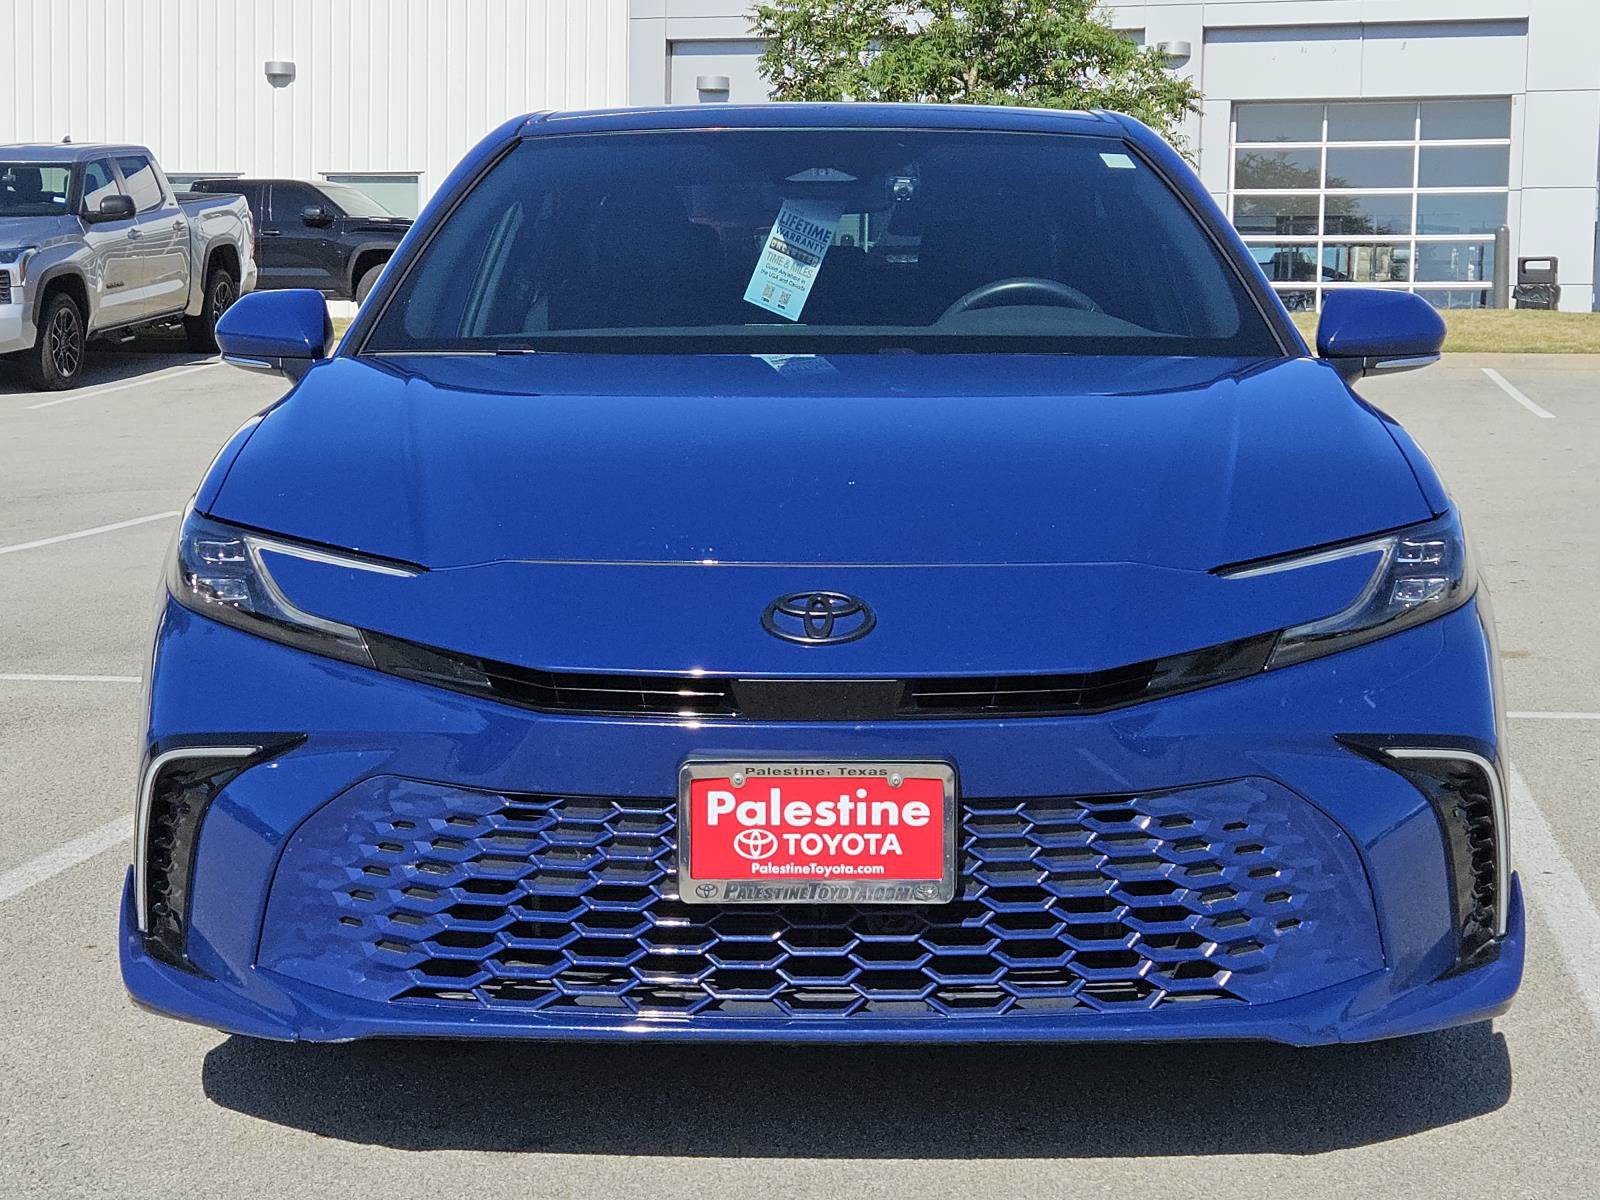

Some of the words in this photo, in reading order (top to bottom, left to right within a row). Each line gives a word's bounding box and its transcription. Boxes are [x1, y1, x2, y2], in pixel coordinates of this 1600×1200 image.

[776, 226, 825, 253] WARRANTY
[778, 211, 832, 243] LIFETIME
[765, 251, 784, 267] TIME
[789, 261, 813, 279] MILES
[745, 767, 830, 776] Palestine,
[838, 767, 888, 776] Texas
[707, 788, 930, 827] Palestine
[783, 833, 903, 856] TOYOTA
[751, 862, 884, 877] PalestineToyota.com
